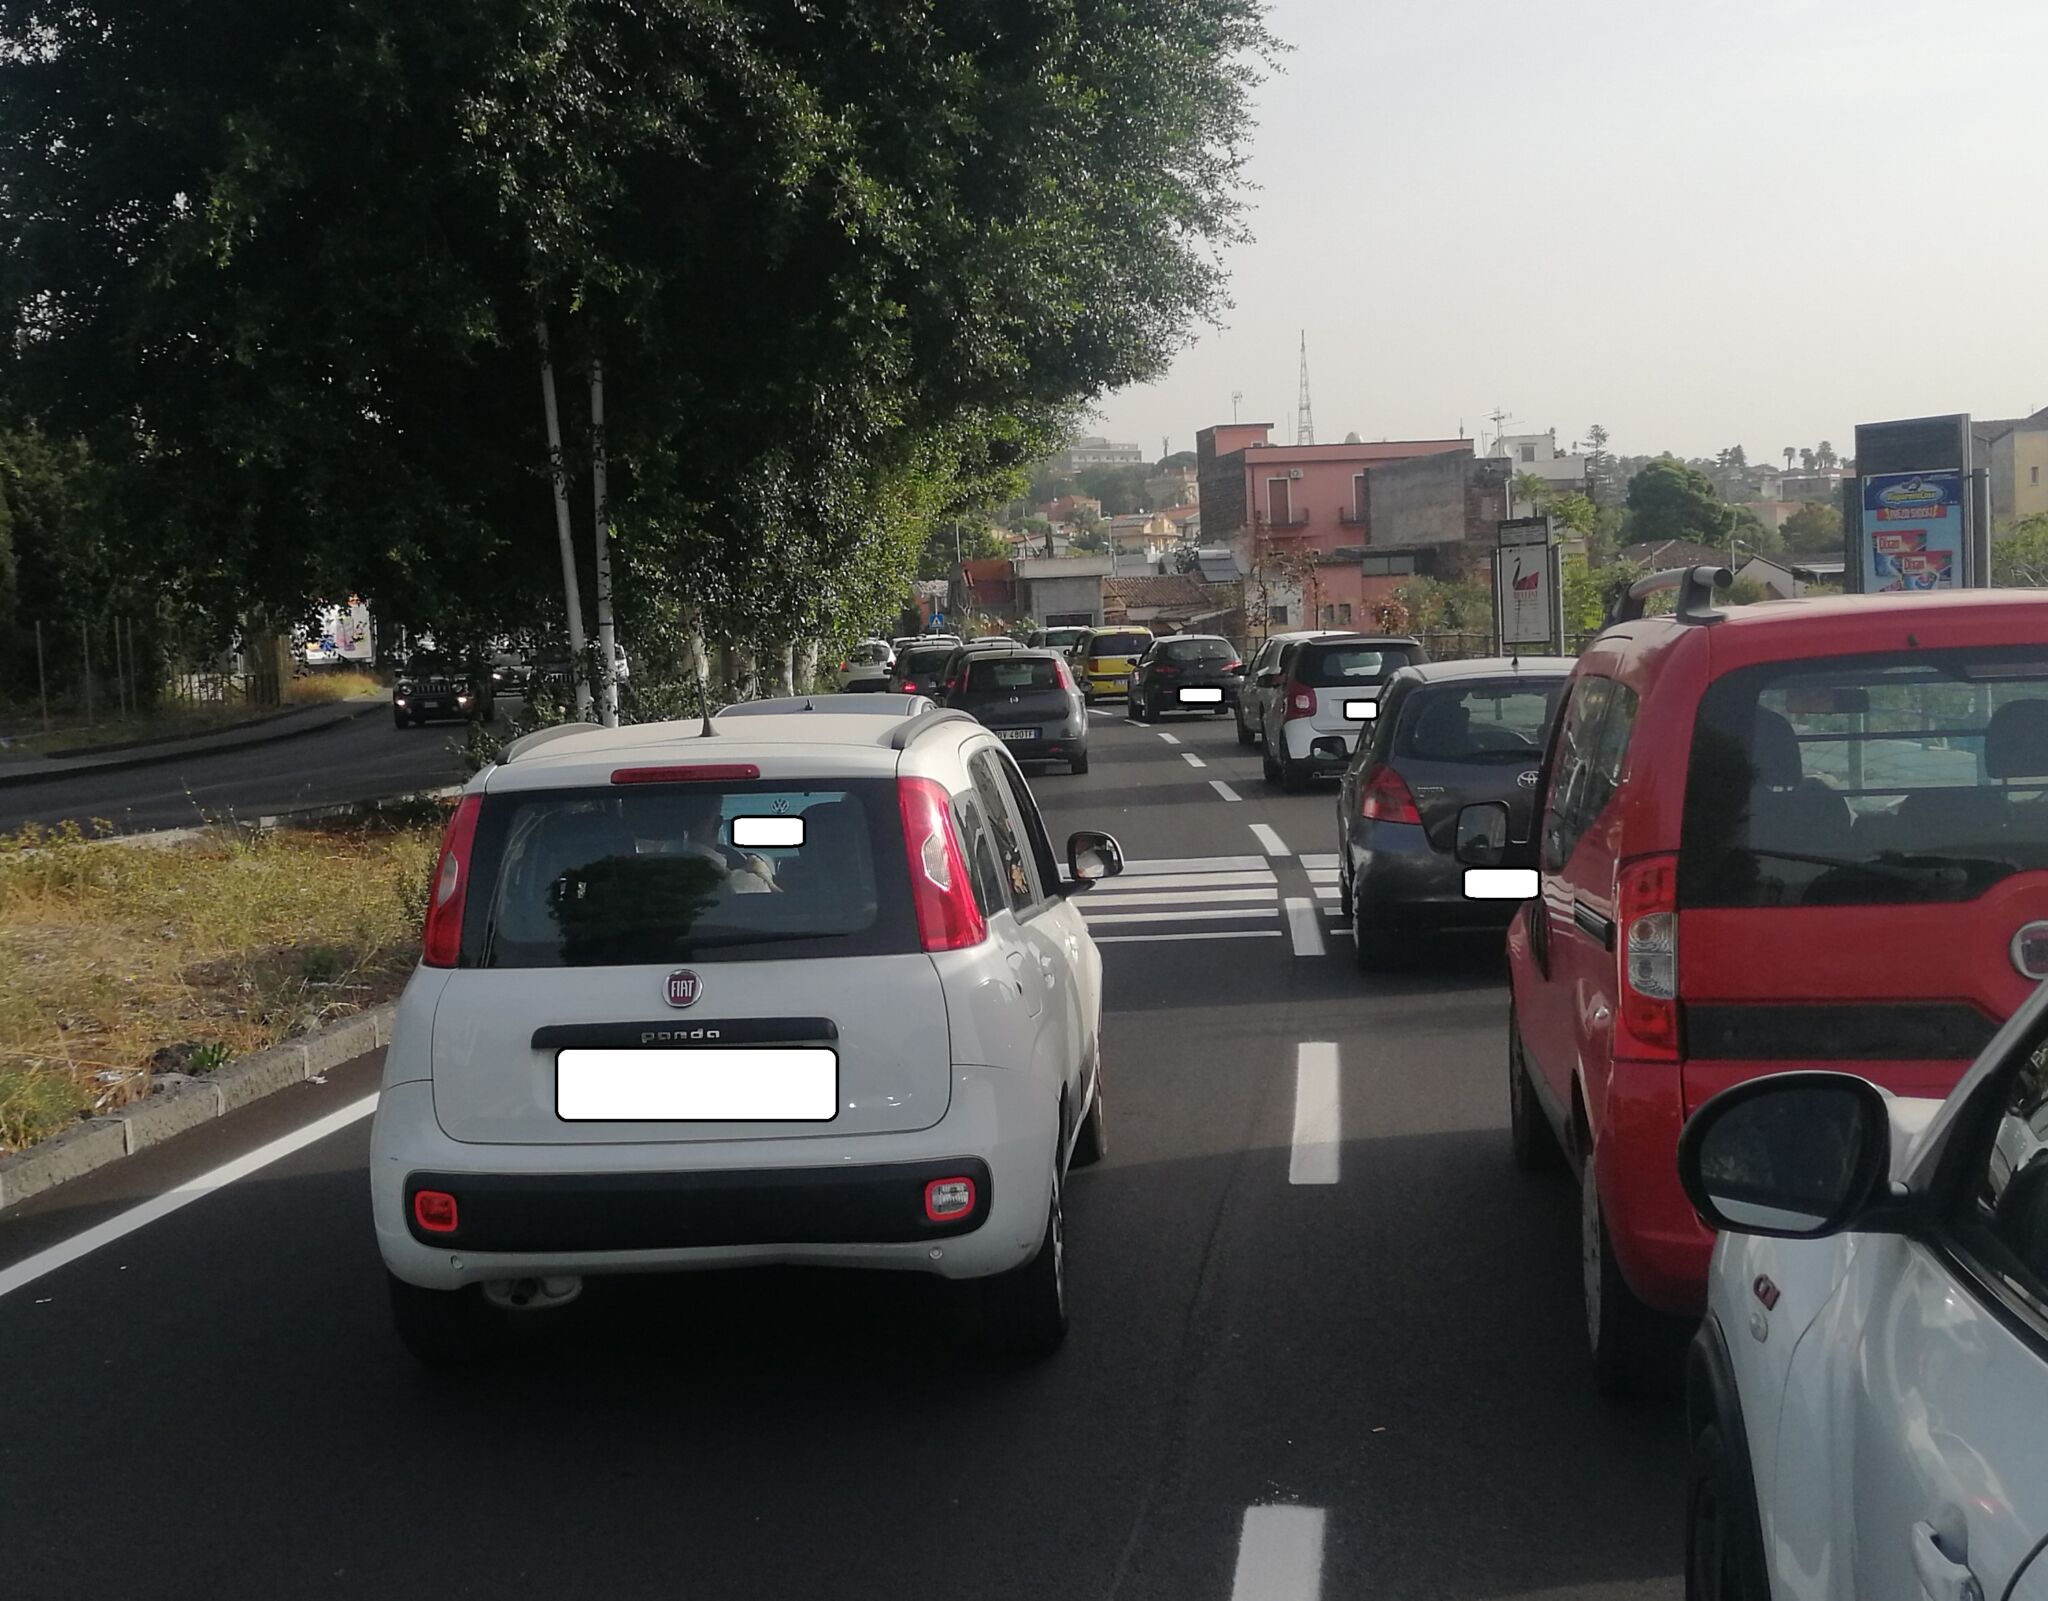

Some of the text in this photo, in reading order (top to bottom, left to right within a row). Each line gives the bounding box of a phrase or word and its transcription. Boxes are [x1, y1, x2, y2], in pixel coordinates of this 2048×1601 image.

[1879, 537, 1900, 549] Dixan
[1904, 558, 1925, 570] Dixan
[671, 980, 695, 998] FIAT
[641, 1028, 720, 1043] panda
